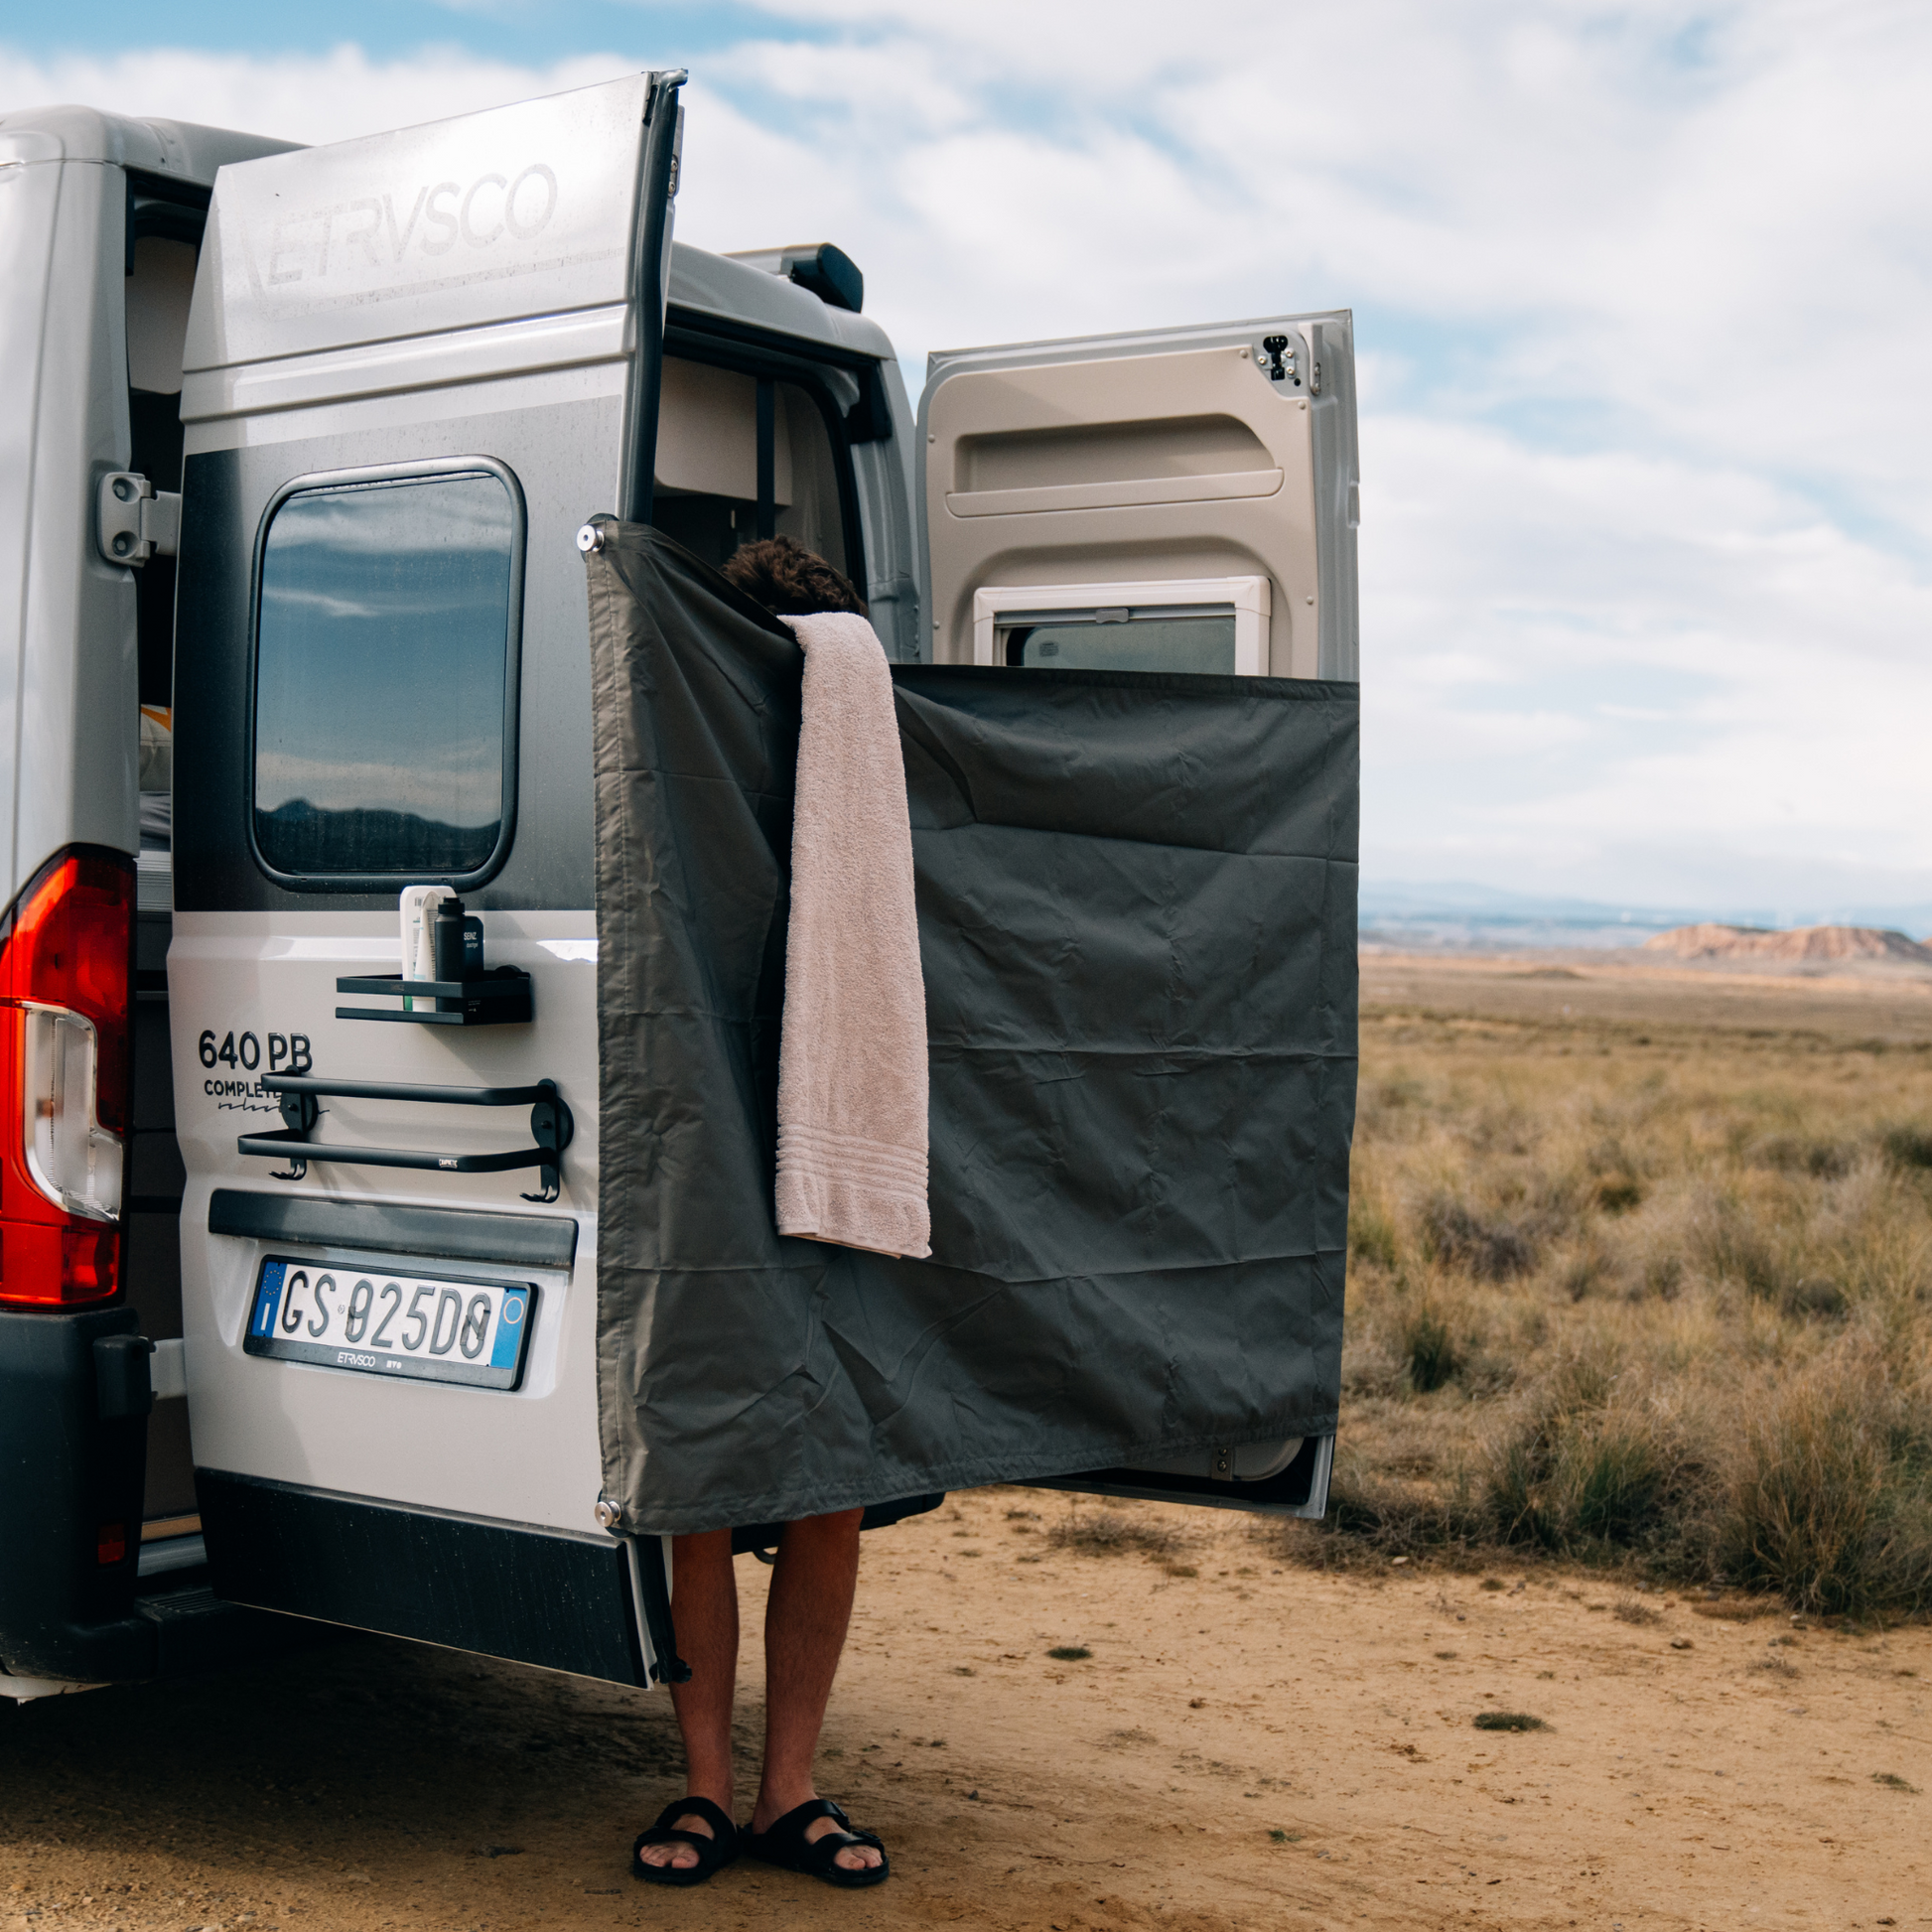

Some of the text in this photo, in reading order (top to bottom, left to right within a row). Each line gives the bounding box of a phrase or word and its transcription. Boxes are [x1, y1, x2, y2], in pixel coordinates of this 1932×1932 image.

[199, 1030, 313, 1072] 640 PB
[281, 1270, 337, 1337] GS
